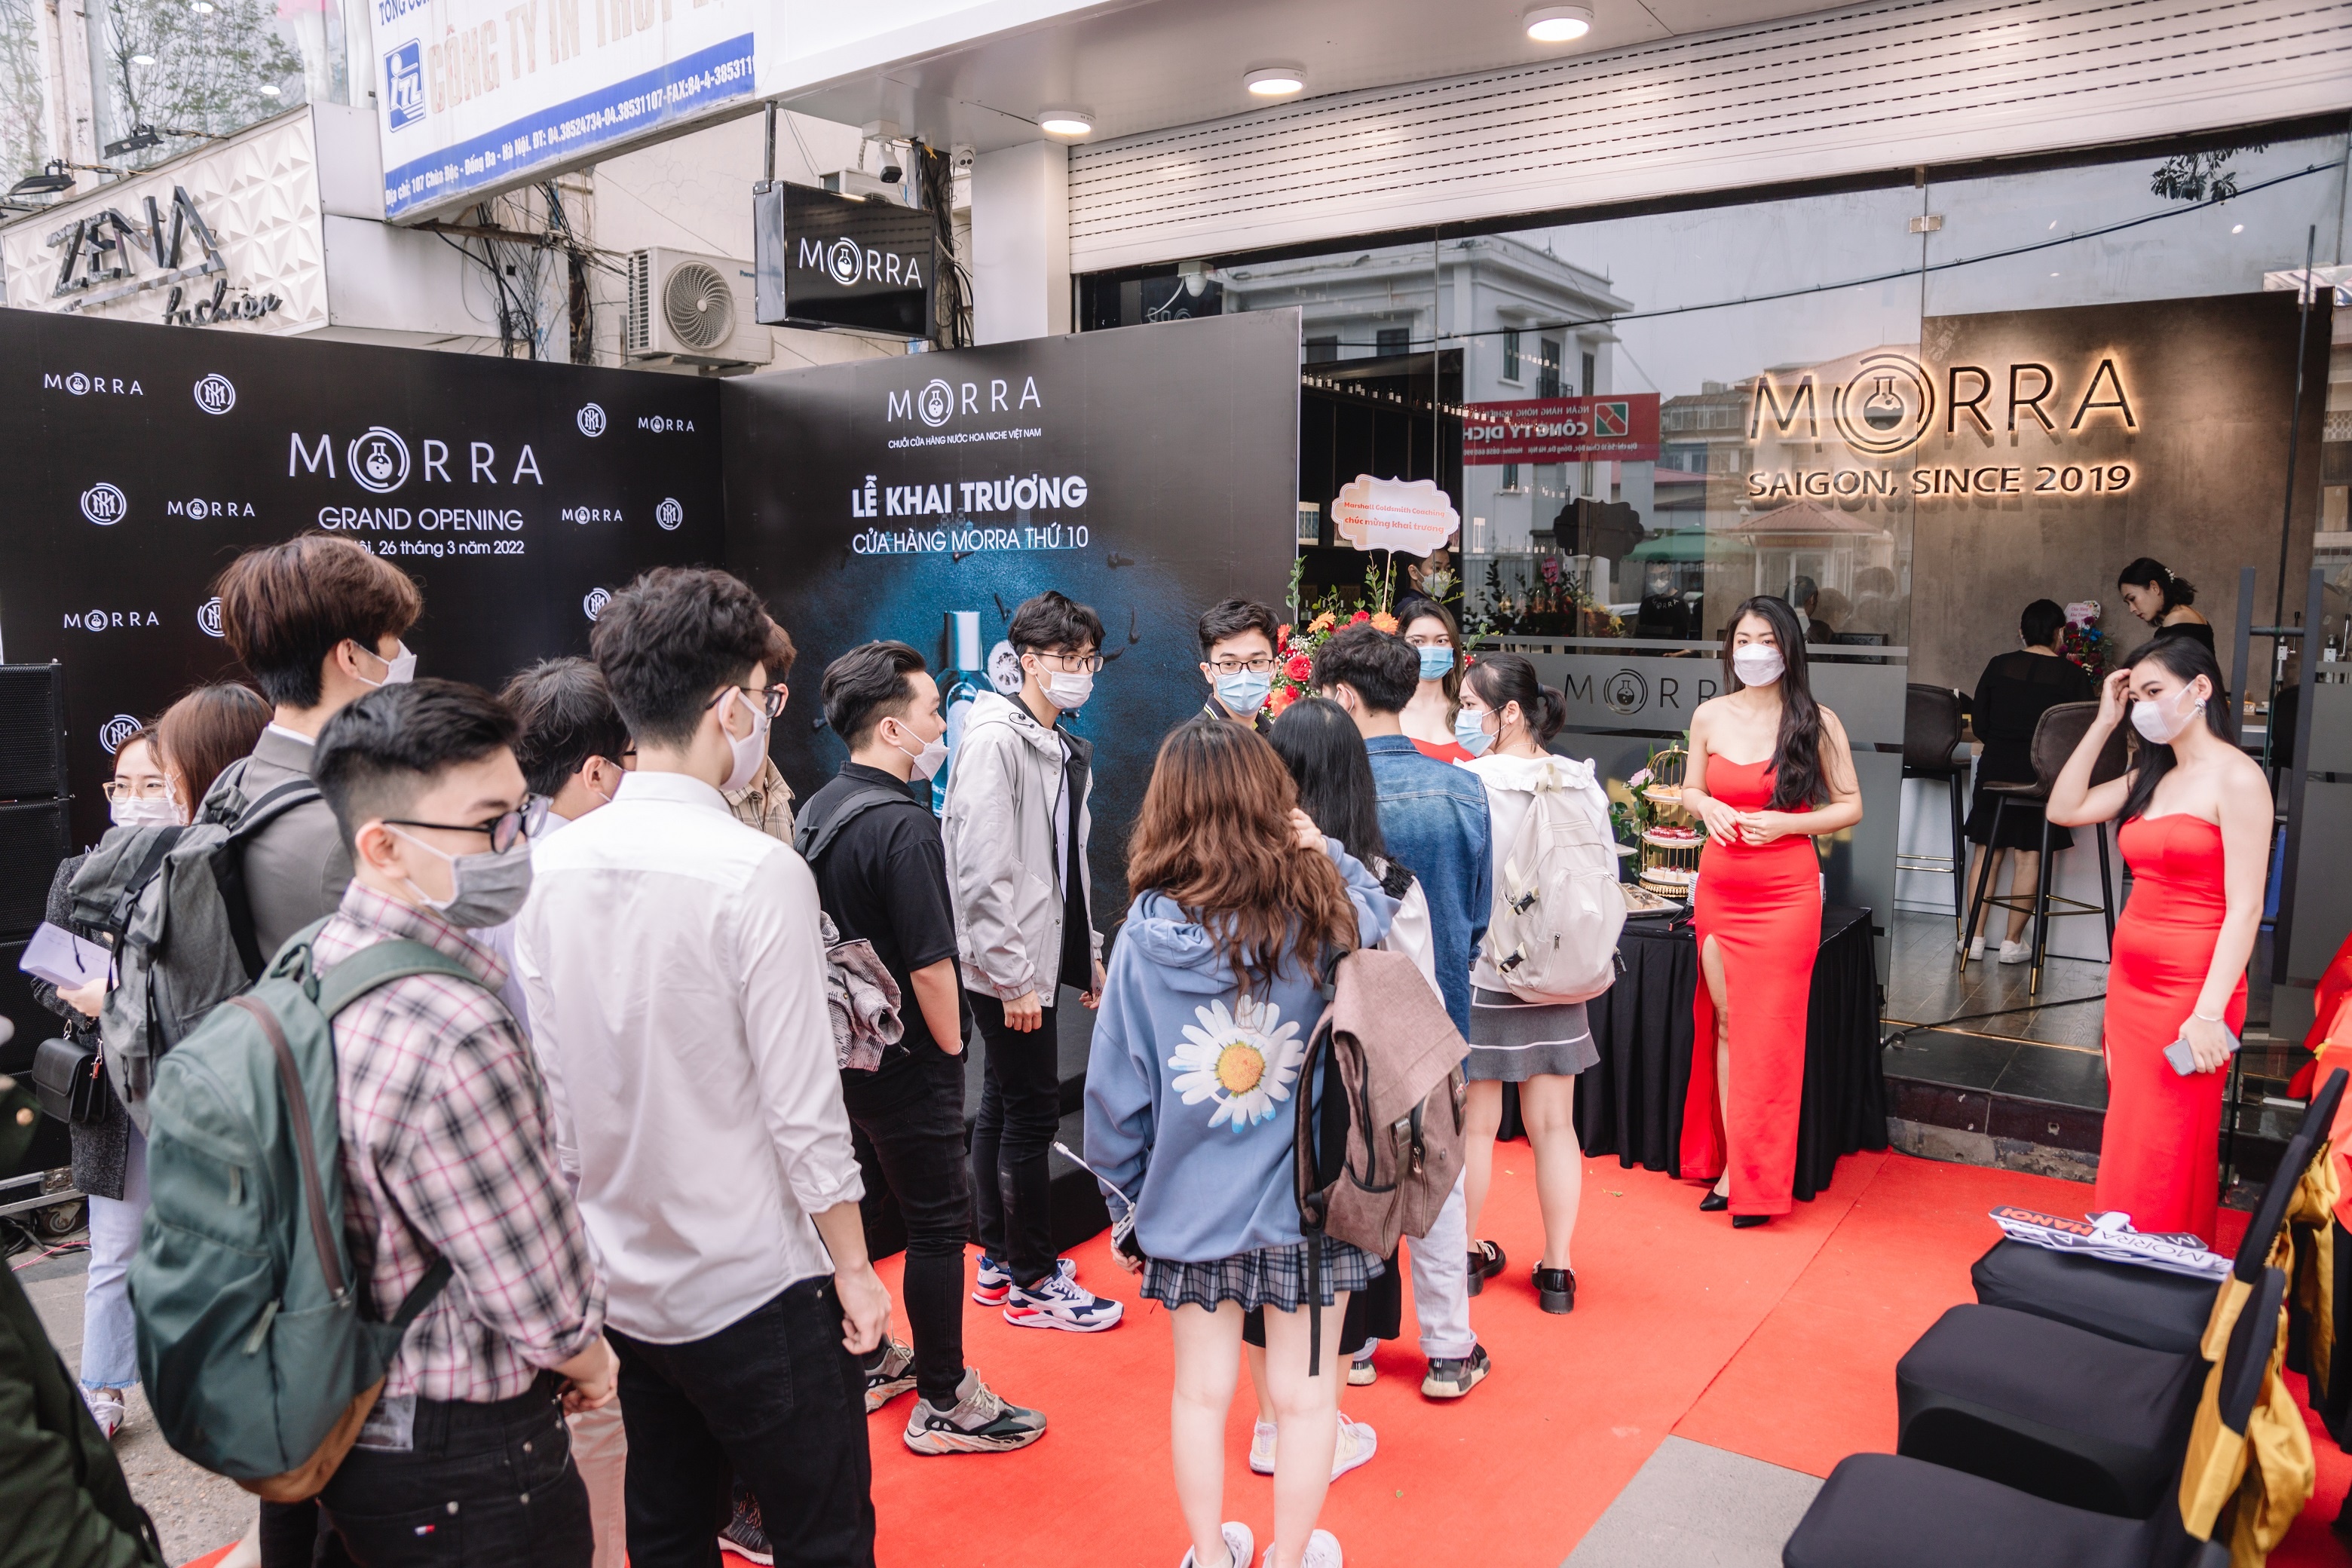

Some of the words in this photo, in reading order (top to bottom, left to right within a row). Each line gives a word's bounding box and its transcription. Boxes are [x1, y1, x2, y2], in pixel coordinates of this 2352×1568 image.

[427, 20, 500, 114] CÔNG
[506, 0, 537, 81] TY
[548, 0, 580, 66] IN
[411, 174, 424, 194] 107
[425, 170, 444, 188] Chùa
[444, 164, 459, 183] Bộc
[464, 154, 485, 176] Đống
[485, 150, 496, 164] Đa
[502, 142, 514, 161] Hà
[533, 129, 547, 149] ĐT:
[47, 185, 226, 299] ZENA
[799, 237, 922, 288] MORRA
[44, 372, 143, 396] MORRA
[887, 376, 1041, 427] MORRA
[1750, 354, 2137, 454] MORRA
[638, 415, 695, 433] MORRA
[888, 436, 910, 449] CHUỖI
[910, 435, 925, 447] CỬA
[926, 433, 946, 446] HÀNG
[947, 431, 968, 444] NƯỚC
[969, 432, 985, 443] HOA
[986, 430, 1007, 441] NICHE
[1007, 427, 1023, 440] VIỆT
[1023, 428, 1041, 437] NAM
[289, 426, 544, 494] MORRA
[852, 475, 877, 517] LỄ
[886, 482, 952, 516] KHAI
[960, 473, 1089, 513] TRƯƠNG
[1749, 468, 1897, 497] SAIGON,
[1911, 467, 2022, 495] SINCE
[2034, 465, 2132, 493] 2019
[167, 498, 256, 520] MORRA
[318, 507, 412, 530] GRAND
[418, 508, 524, 531] OPENING
[562, 506, 623, 525] MORRA
[1343, 501, 1375, 510] Marshall
[1375, 504, 1411, 513] Goldsmith
[1412, 508, 1445, 518] Coaching
[1344, 516, 1364, 525] chúc
[1364, 517, 1391, 528] mừng
[1392, 521, 1413, 529] khai
[1413, 524, 1444, 534] trương
[379, 541, 397, 555] 26
[400, 540, 444, 558] tháng
[447, 541, 456, 555] 3
[459, 541, 491, 555] năm
[494, 541, 525, 555] 2022
[852, 527, 890, 554] CỬA
[894, 528, 946, 553] HÀNG
[951, 529, 1021, 551] MORRA
[1024, 522, 1061, 549] THỨ
[1067, 525, 1089, 548] 10
[64, 609, 160, 632] MORRA
[1564, 669, 1717, 715] MORR
[2000, 1208, 2094, 1236] HANOI
[2101, 1230, 2206, 1263] MORRA
